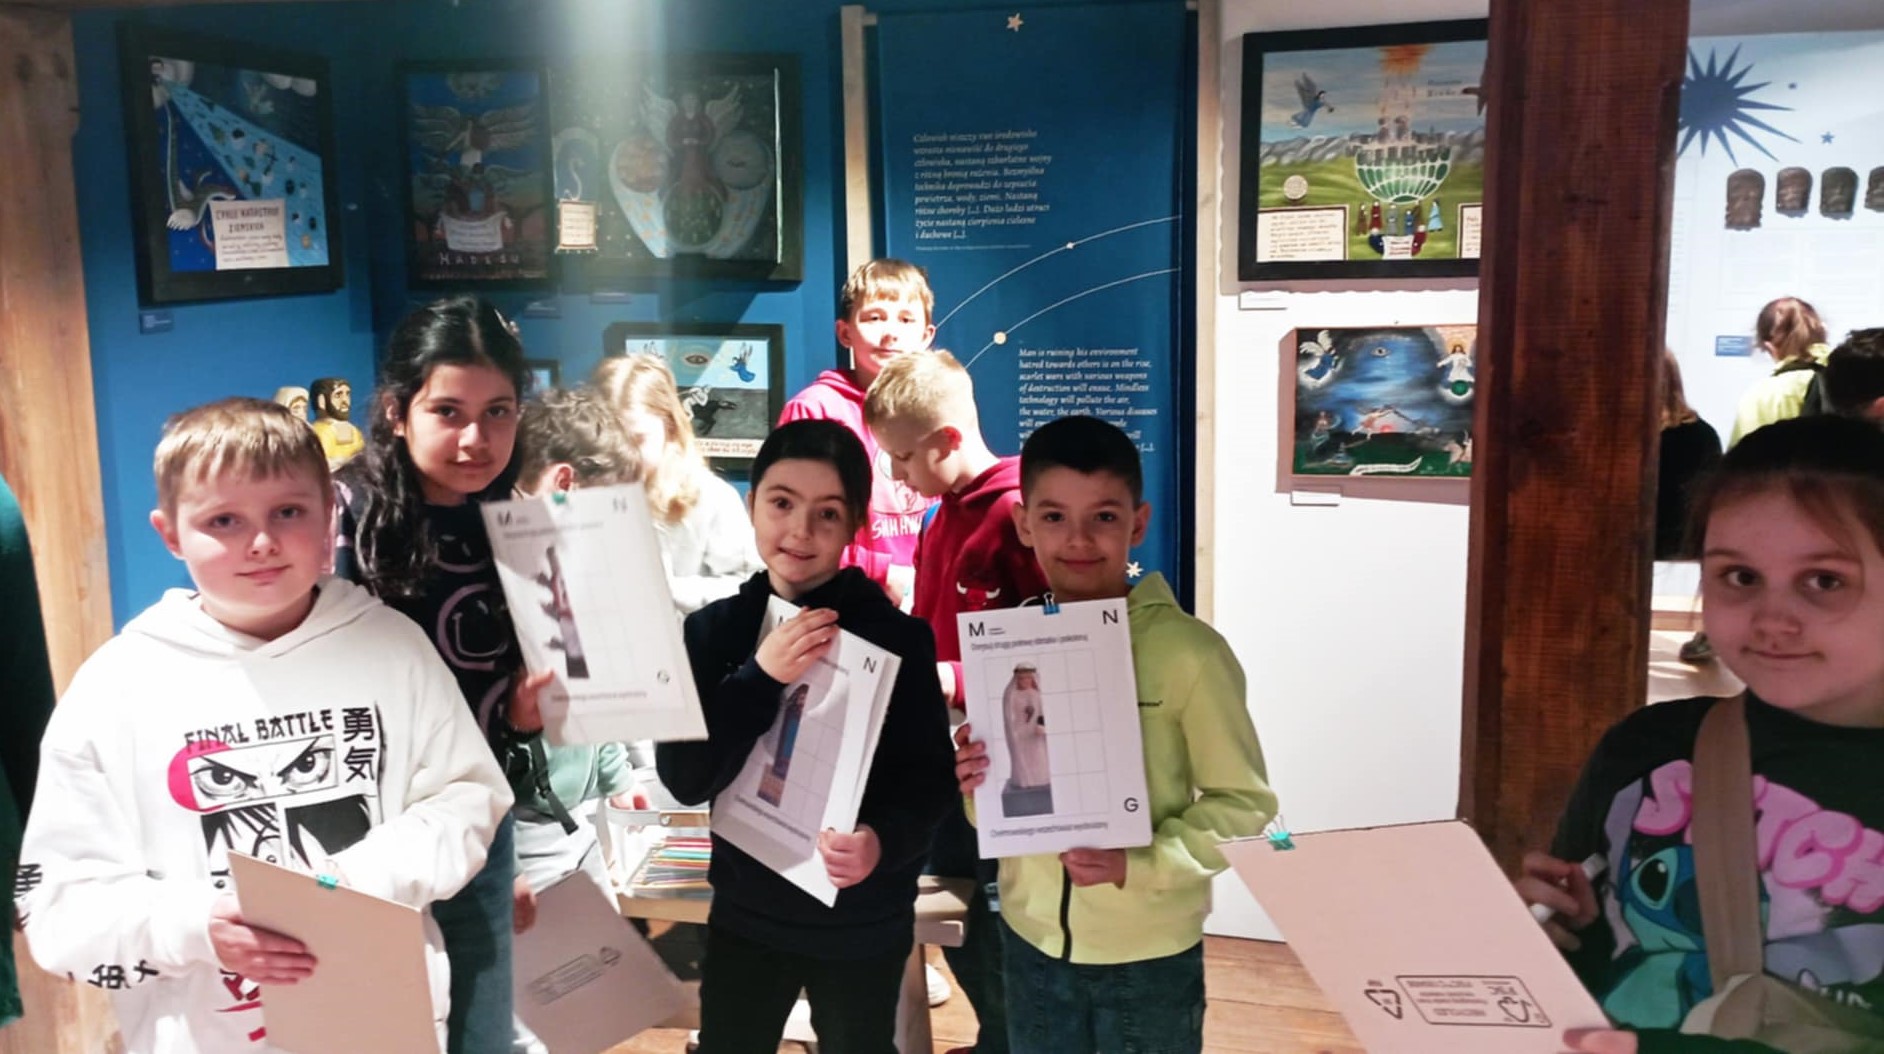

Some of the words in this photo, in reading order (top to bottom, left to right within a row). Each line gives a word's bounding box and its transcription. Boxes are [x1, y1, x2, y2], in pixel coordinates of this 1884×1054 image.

[920, 231, 952, 239] duchowe
[1019, 348, 1036, 356] Man
[1045, 349, 1074, 358] ruining
[1077, 348, 1087, 356] his
[1019, 360, 1043, 368] hatred
[1046, 360, 1075, 368] towards
[1077, 360, 1102, 368] others
[1020, 372, 1043, 380] scarlet
[1115, 373, 1147, 381] weapons
[1019, 384, 1027, 393] of
[1028, 384, 1070, 392] destruction
[1116, 384, 1148, 392] Mindless
[1020, 397, 1058, 405] technology
[1061, 395, 1075, 403] will
[1077, 396, 1102, 405] pollute
[1102, 609, 1119, 625] N
[968, 621, 985, 637] M
[863, 656, 877, 673] N
[184, 722, 250, 753] FINAL
[255, 708, 334, 741] BATTLE
[341, 706, 378, 784] 勇気
[1123, 796, 1140, 813] G
